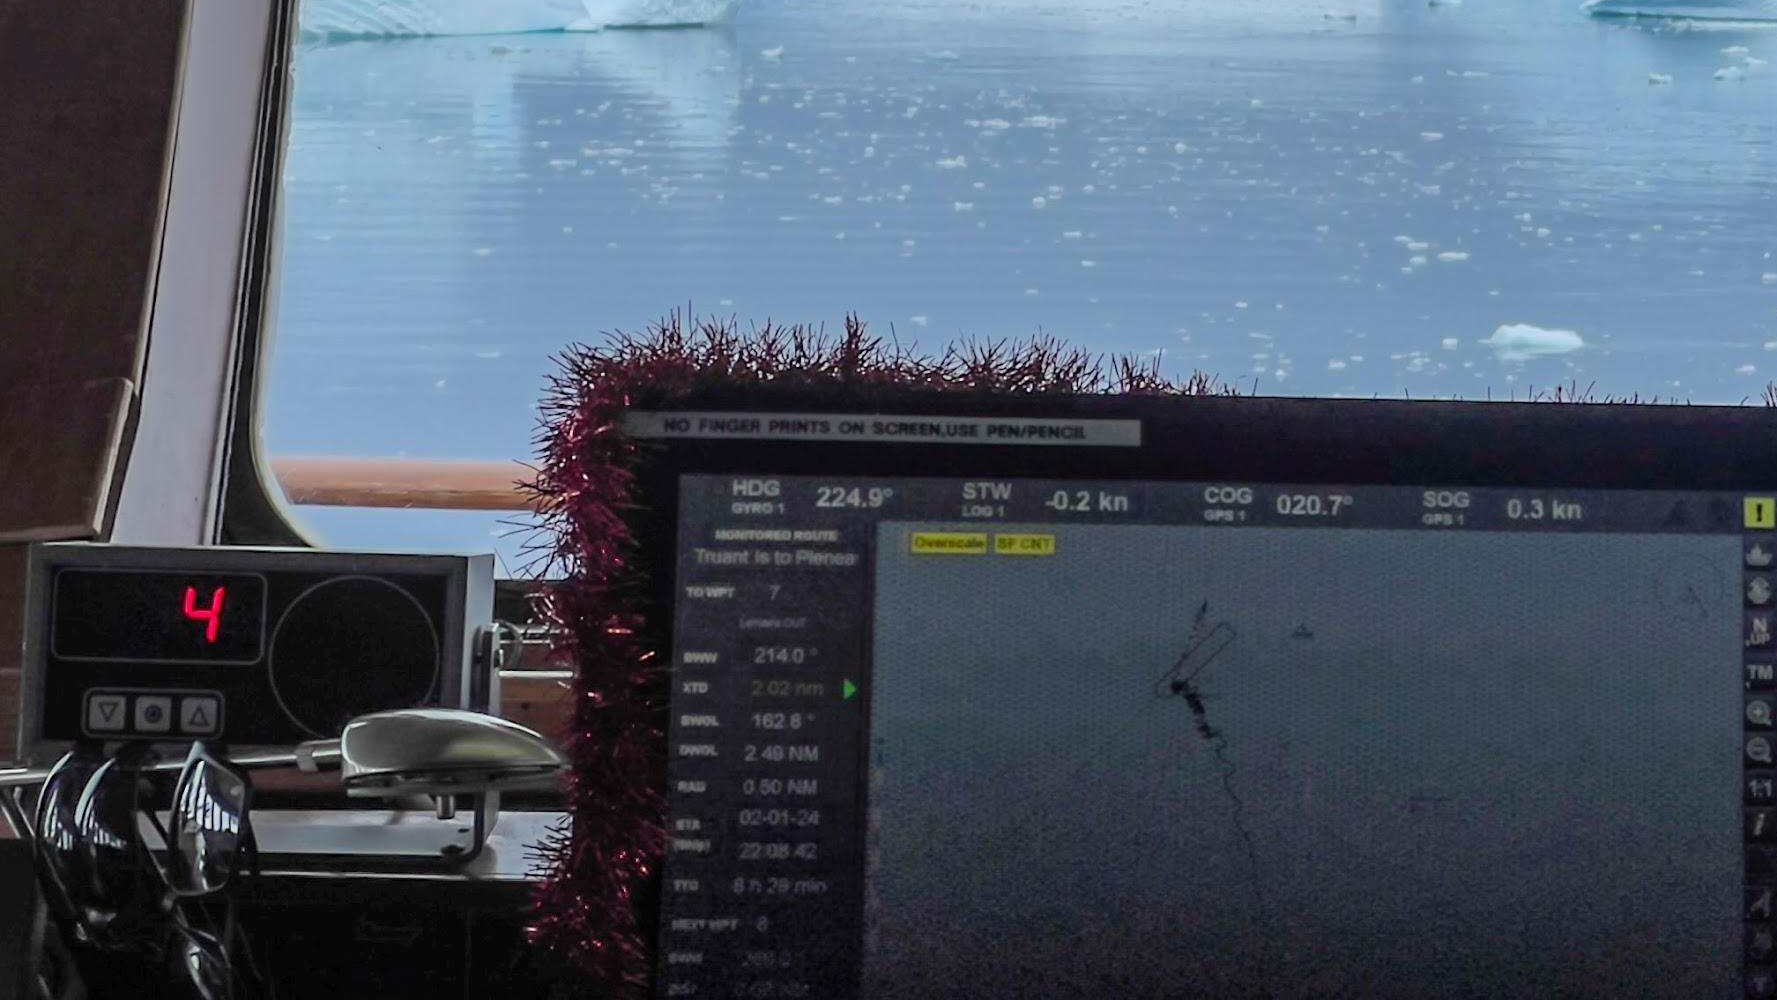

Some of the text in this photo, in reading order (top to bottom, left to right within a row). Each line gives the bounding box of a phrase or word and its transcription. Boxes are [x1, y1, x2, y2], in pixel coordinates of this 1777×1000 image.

[663, 418, 690, 433] NO
[697, 418, 760, 434] FINGER
[768, 419, 830, 435] PRINTS
[838, 420, 865, 435] ON
[986, 423, 1086, 440] PEN/PENCIL
[732, 479, 894, 508] HDG 224.9°
[961, 482, 1129, 512] STW -0.2 kn
[1203, 486, 1353, 517] COG 020.7°
[731, 502, 774, 515] GYRO
[961, 505, 995, 518] LOG
[1421, 491, 1583, 521] SOG 0.3 kn
[1203, 508, 1235, 522] GPS
[1421, 512, 1454, 526] GPS
[715, 529, 840, 542] MONITORED ROUTE
[913, 535, 985, 551] Overscale
[1019, 537, 1053, 552] CNT
[695, 548, 751, 566] Truant
[754, 549, 770, 566] is
[773, 550, 792, 567] to
[768, 585, 781, 601] 7
[181, 584, 227, 645] 4
[1752, 617, 1767, 631] N
[1751, 632, 1771, 646] UP
[1748, 664, 1774, 680] TM
[682, 680, 825, 697] XTD 2.02 nm
[788, 744, 819, 762] NM
[785, 779, 818, 796] NM
[738, 809, 821, 827] 02-01-24
